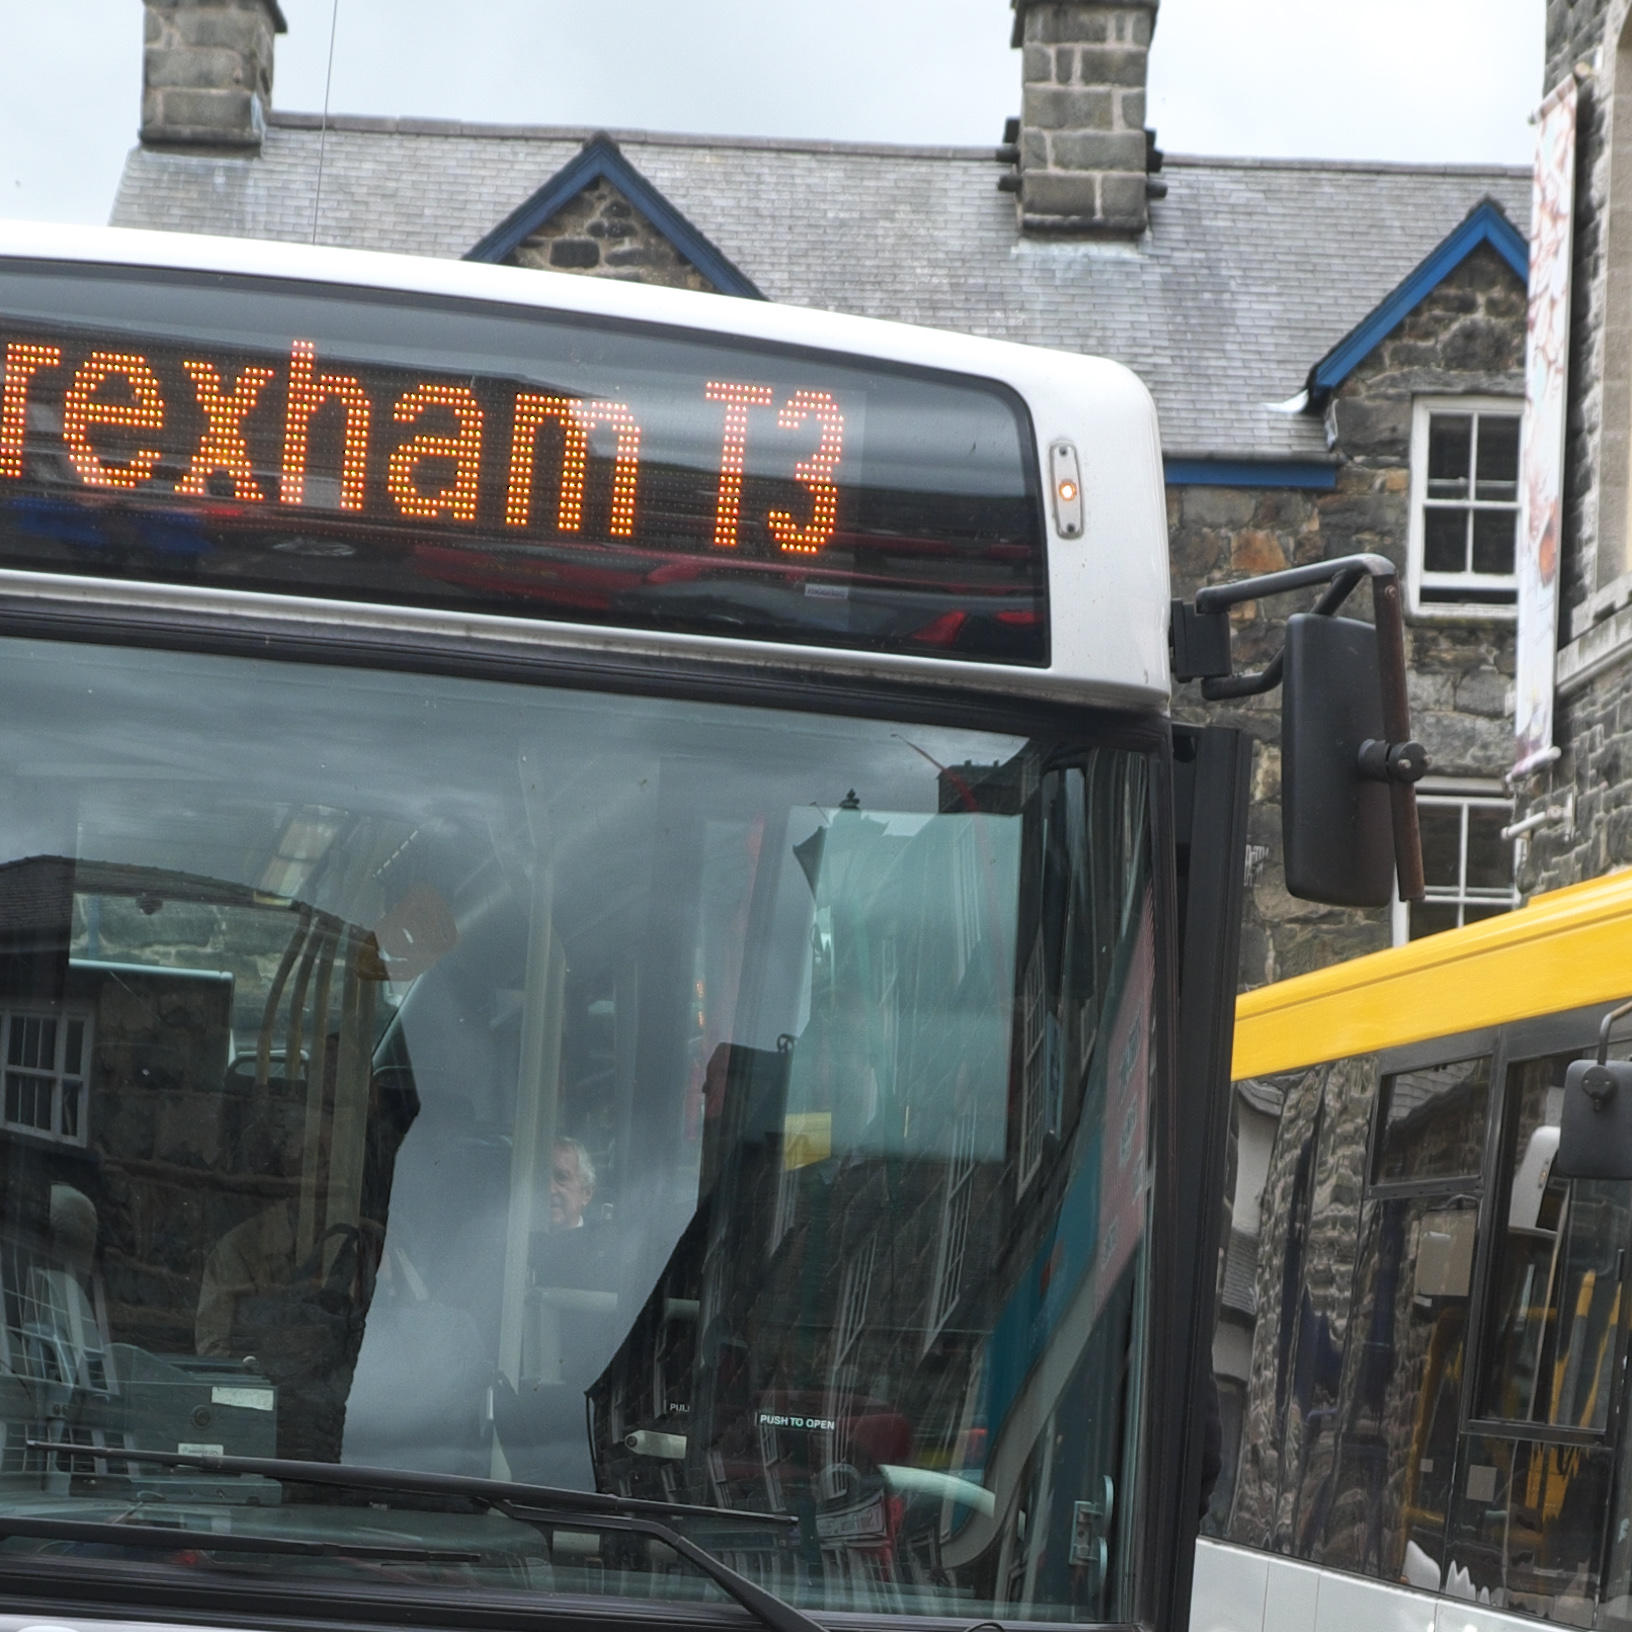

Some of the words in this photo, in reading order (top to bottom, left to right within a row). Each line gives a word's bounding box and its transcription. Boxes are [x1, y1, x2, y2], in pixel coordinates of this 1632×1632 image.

[705, 380, 845, 558] T3
[759, 1413, 789, 1427] PUSH
[789, 1417, 805, 1428] TO
[805, 1417, 836, 1430] OPEN
